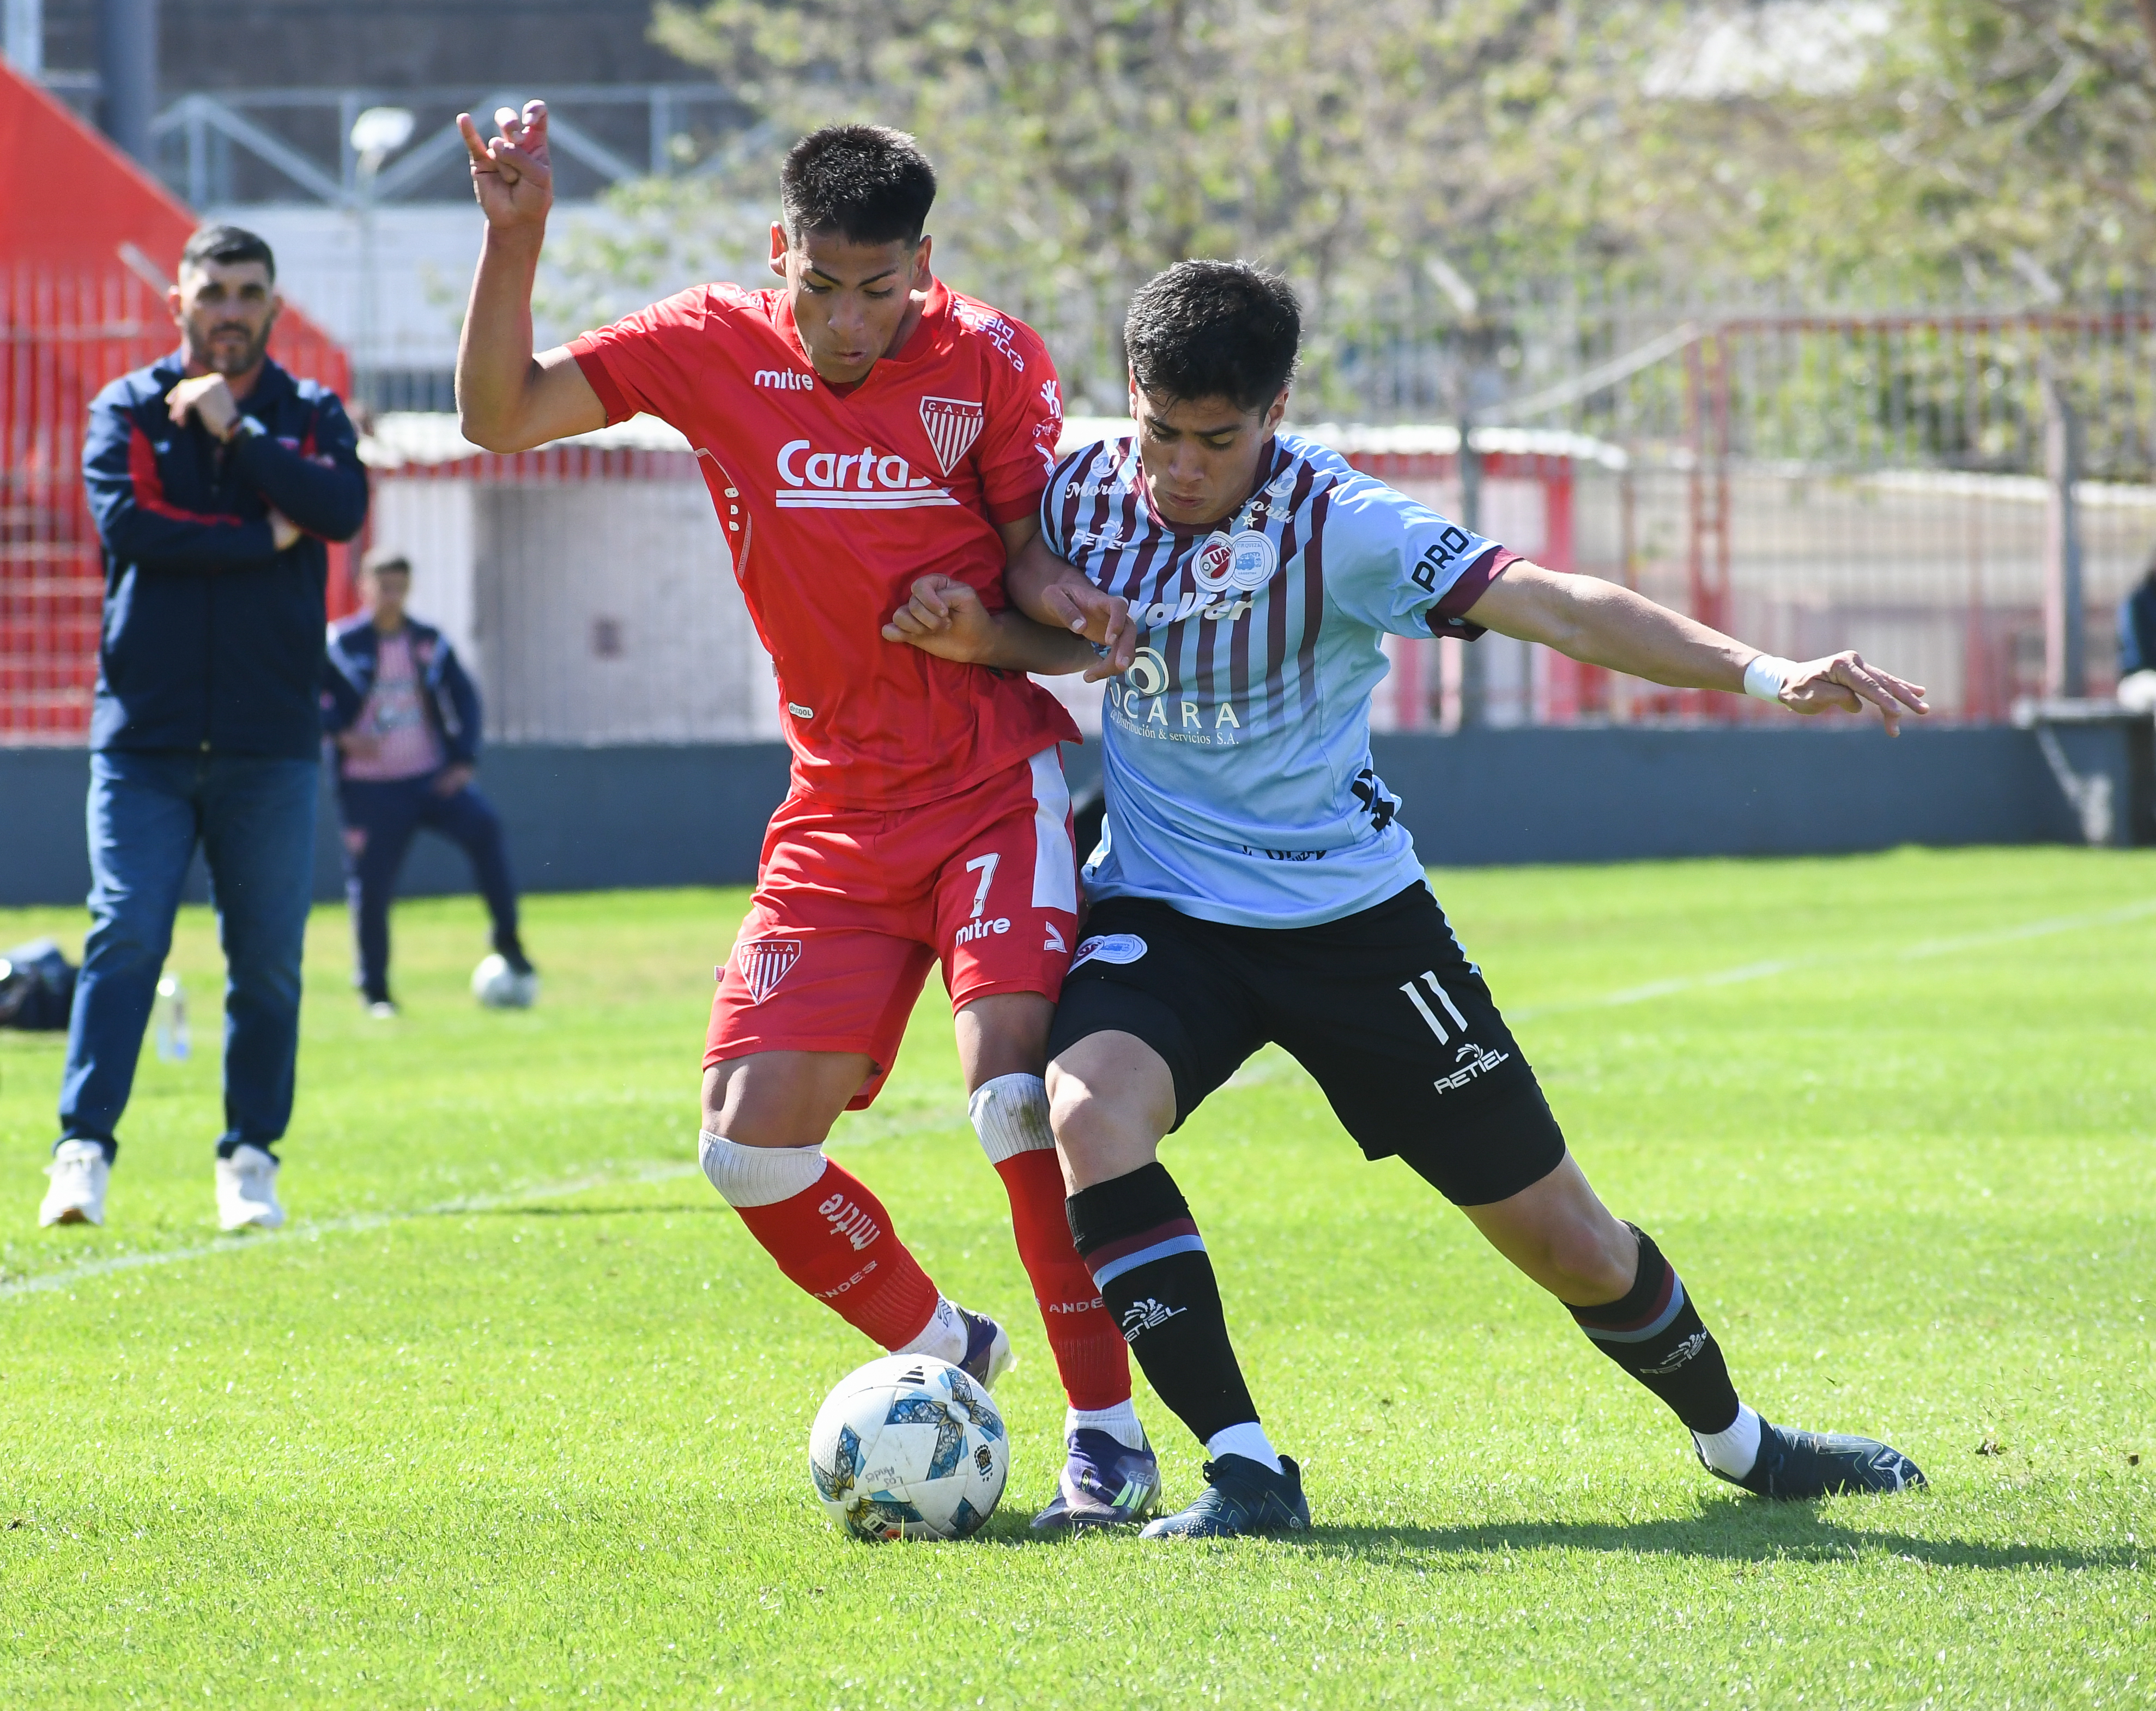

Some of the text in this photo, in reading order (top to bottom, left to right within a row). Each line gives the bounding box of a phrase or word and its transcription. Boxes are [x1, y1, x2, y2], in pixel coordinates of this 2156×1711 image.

[754, 367, 813, 391] mitre
[1209, 547, 1232, 566] UAI
[1412, 526, 1475, 594] PRO
[1117, 710, 1156, 739] Distribución
[1158, 728, 1167, 741] &
[1170, 731, 1211, 745] servicios
[1216, 732, 1239, 745] S.A.
[966, 852, 1001, 919] 7
[955, 918, 1011, 949] mitre
[1398, 970, 1468, 1046] 11
[1433, 1048, 1510, 1095] RETIEL
[819, 1193, 881, 1252] mitre
[1123, 1307, 1188, 1343] ETIEL
